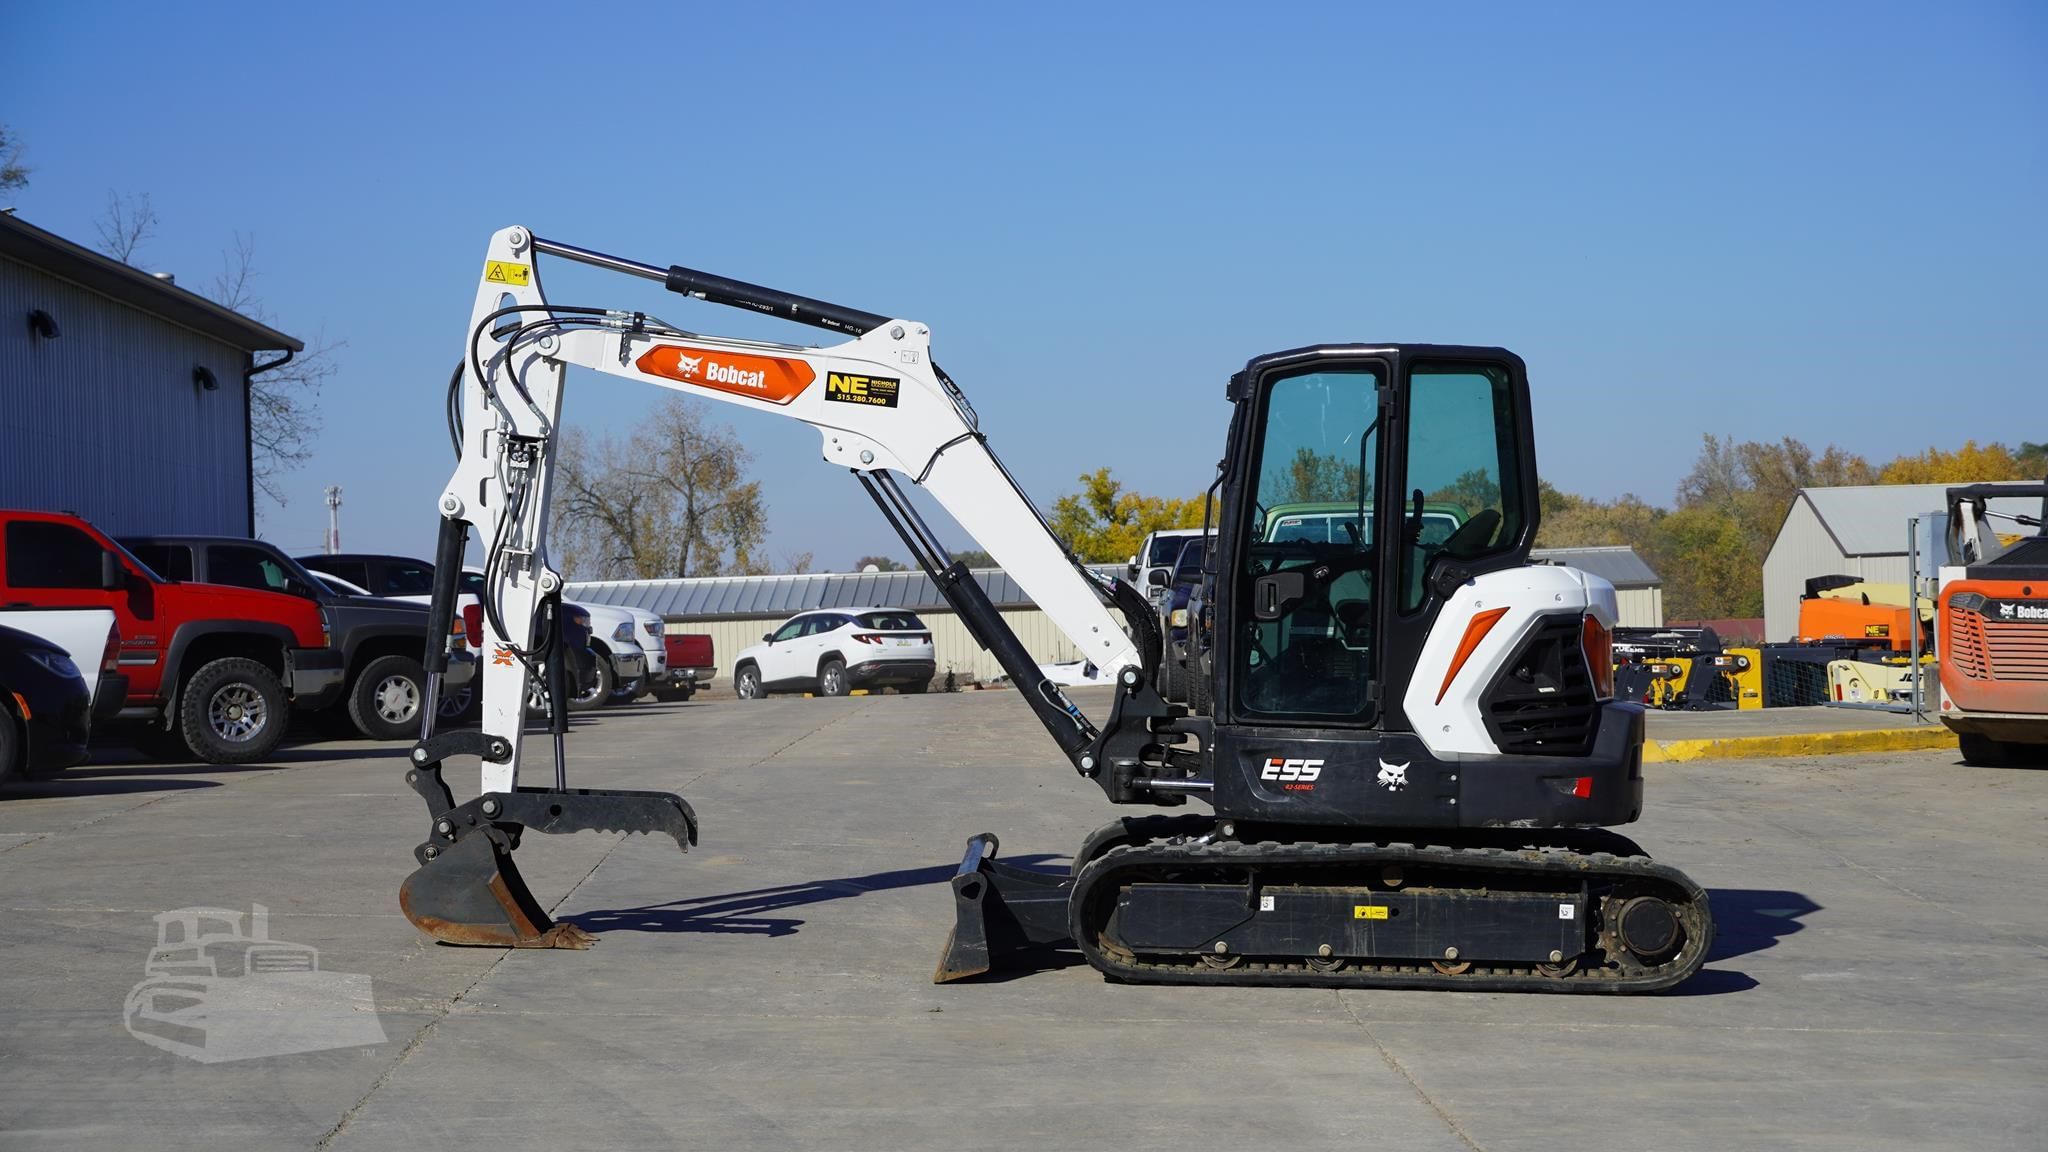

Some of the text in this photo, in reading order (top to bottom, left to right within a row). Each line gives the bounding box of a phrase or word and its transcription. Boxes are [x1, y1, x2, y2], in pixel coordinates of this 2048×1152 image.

[706, 362, 765, 388] Bobcat
[828, 374, 869, 395] NE
[837, 394, 886, 405] 515.280.7600
